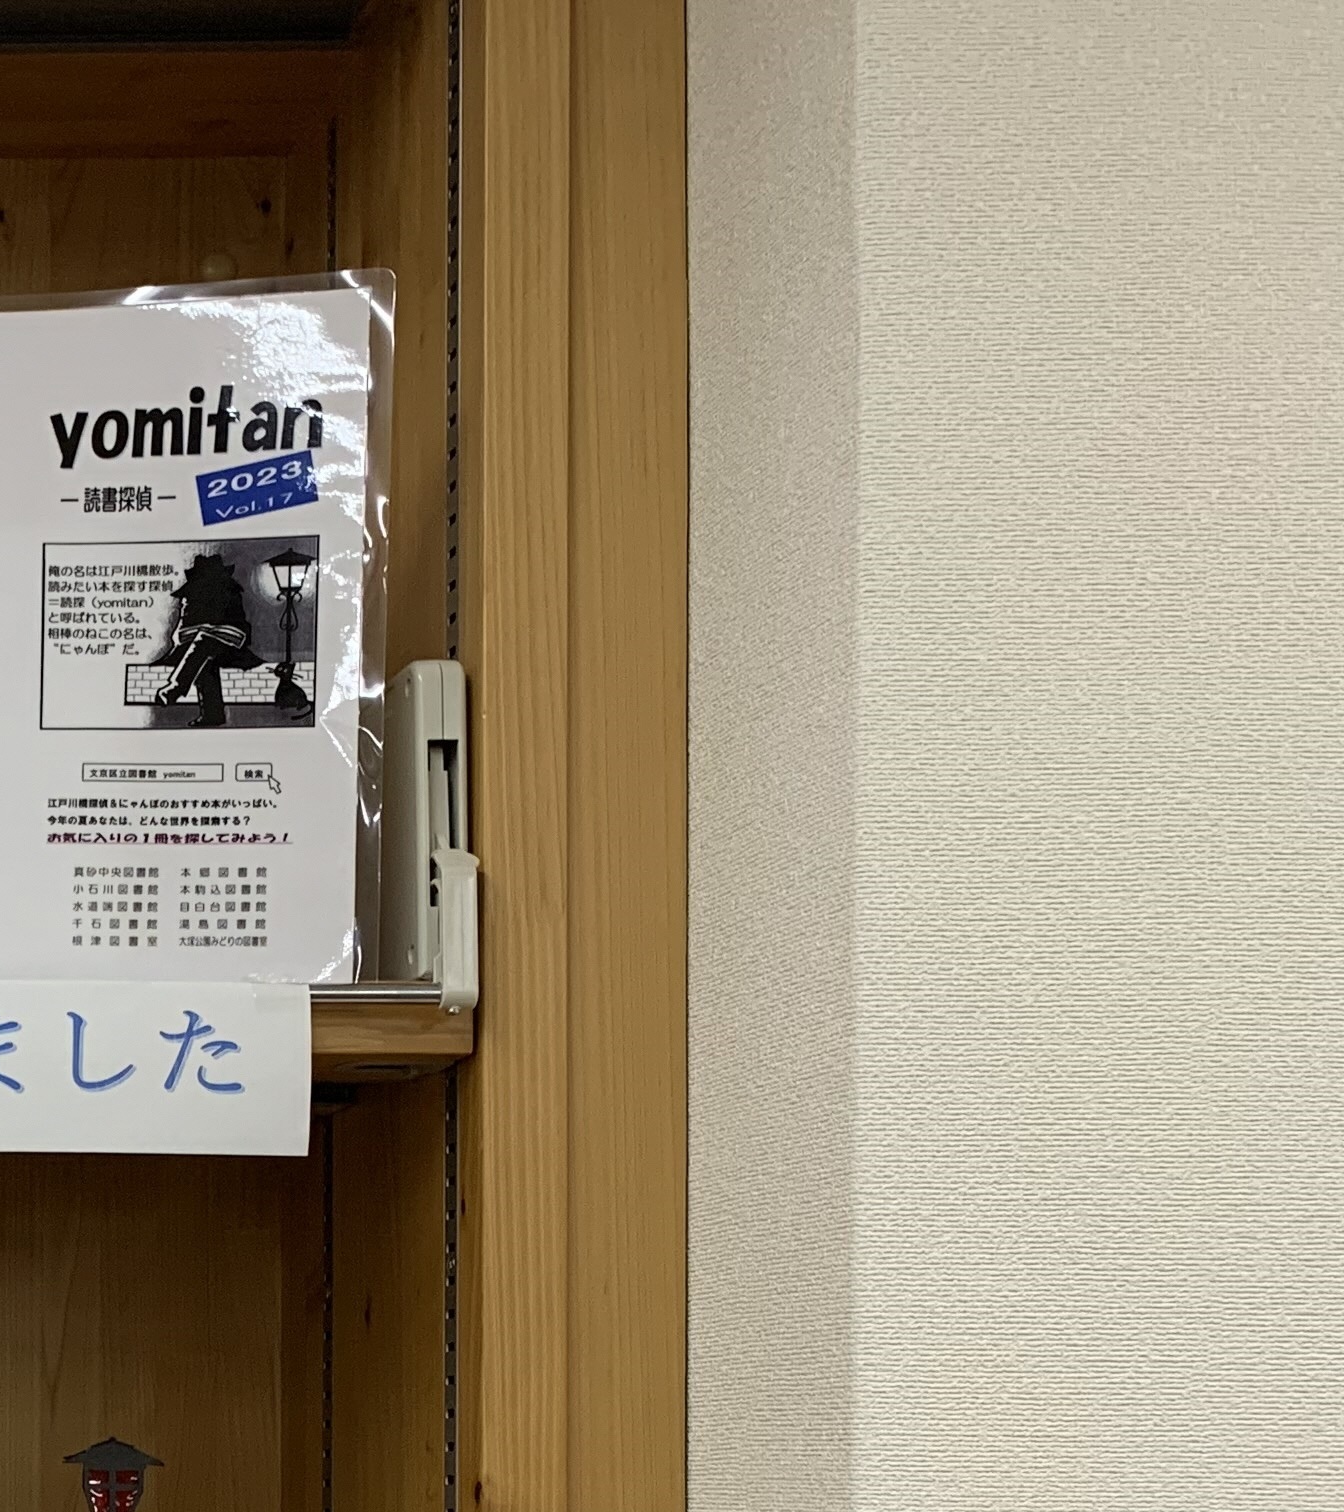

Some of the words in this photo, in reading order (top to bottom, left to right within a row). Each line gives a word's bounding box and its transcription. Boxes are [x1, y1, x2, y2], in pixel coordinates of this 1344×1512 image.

[50, 385, 323, 469] yomitan
[206, 461, 302, 499] 2023
[84, 486, 152, 513] 読書探偵
[215, 492, 293, 518] Vol.17
[48, 580, 174, 593] 読みたい本を探す探偵
[48, 612, 141, 624] と呼ばれている。
[48, 628, 153, 640] 相棒のねこの名は、
[89, 768, 158, 779] 文京区立図書館
[244, 768, 264, 780] 検索
[74, 866, 160, 878] 真砂中央図書館
[180, 866, 268, 878] 本郷図書館
[73, 884, 159, 896] 小石川図書館
